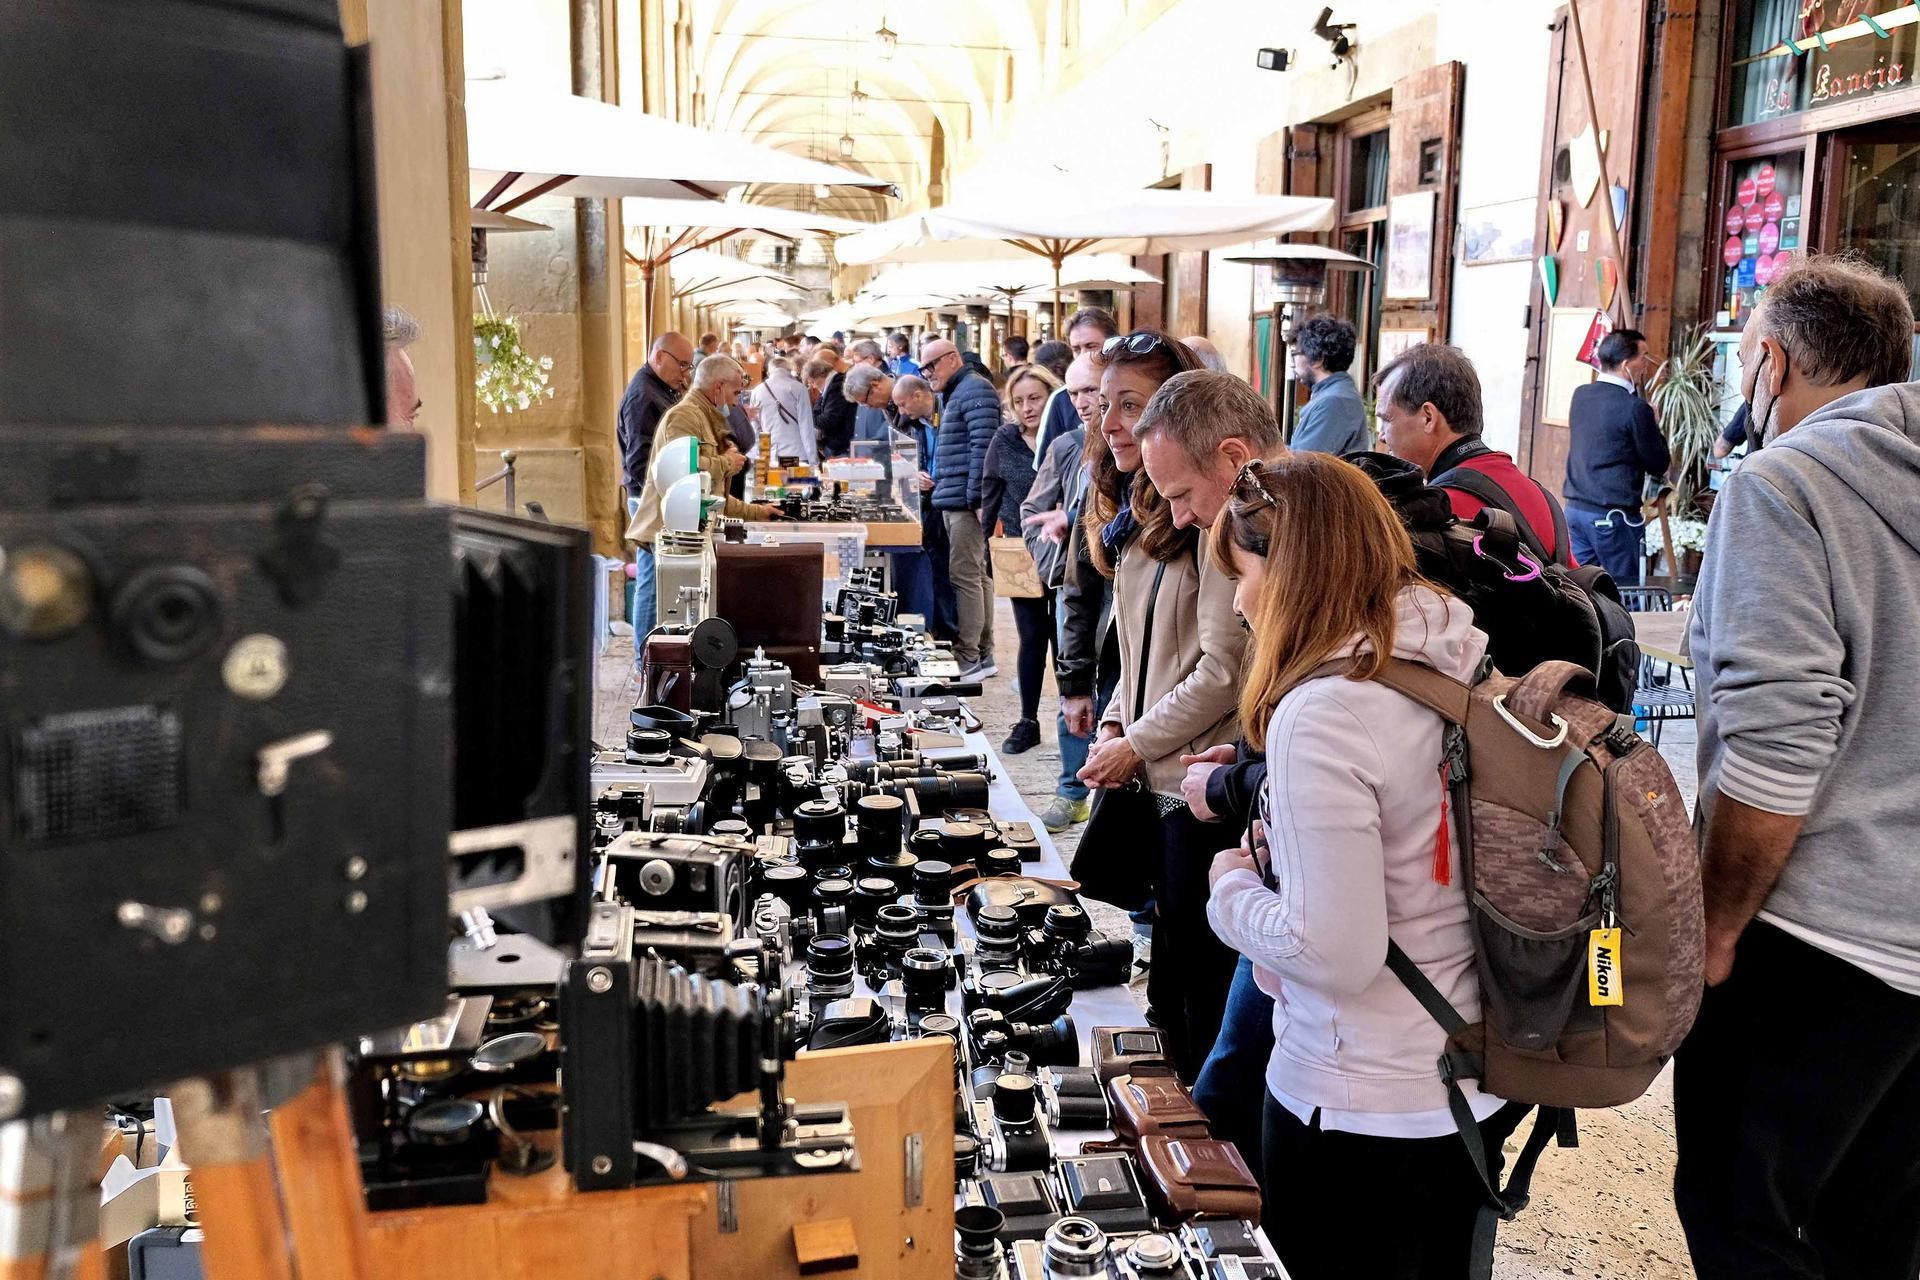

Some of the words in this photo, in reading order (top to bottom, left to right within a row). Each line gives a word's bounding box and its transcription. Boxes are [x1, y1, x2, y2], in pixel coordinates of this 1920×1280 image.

[1760, 78, 1791, 116] La
[1810, 56, 1904, 104] Lancia
[1597, 946, 1612, 997] Nikon
